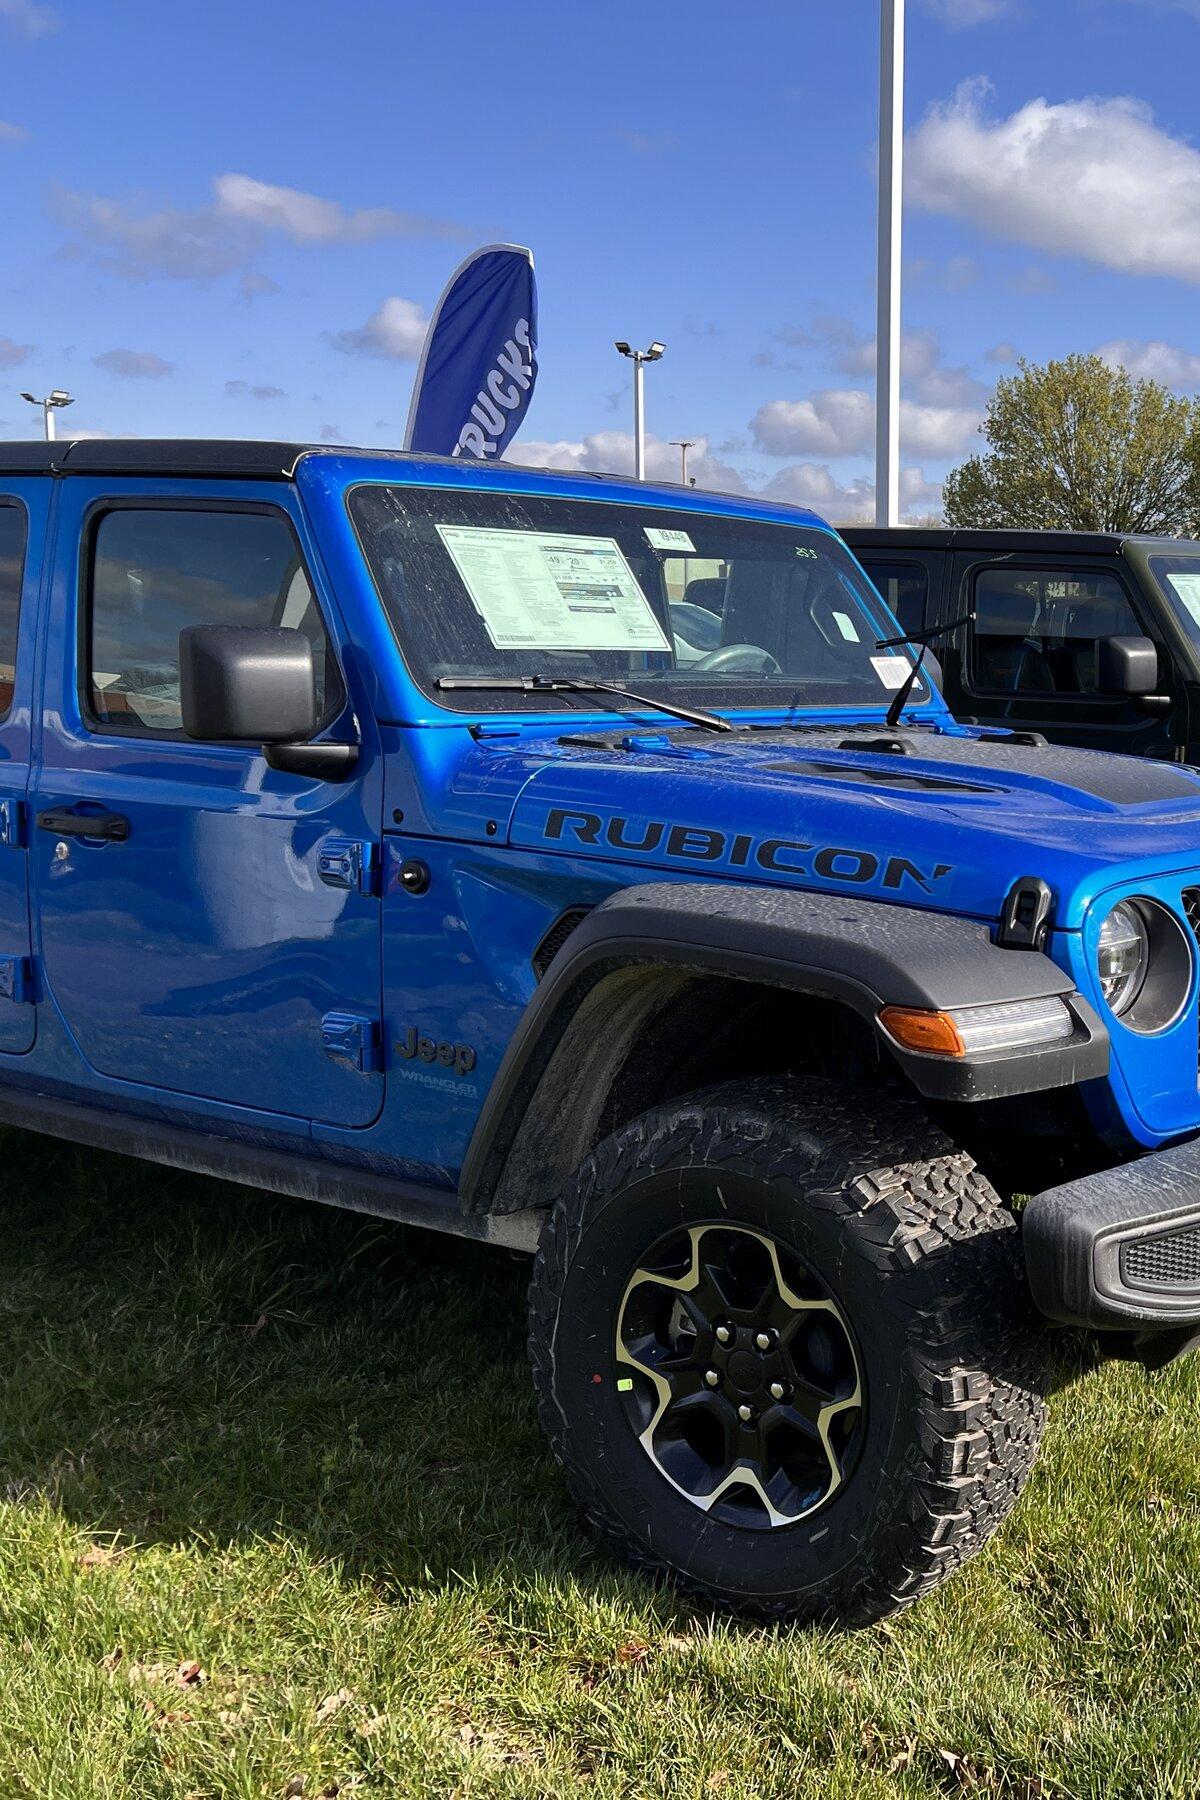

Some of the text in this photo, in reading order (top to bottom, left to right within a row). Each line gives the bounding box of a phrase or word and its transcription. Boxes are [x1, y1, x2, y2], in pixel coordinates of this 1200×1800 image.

[543, 808, 957, 895] RUBICON
[395, 1026, 477, 1077] Jeep
[399, 1068, 478, 1094] WRANGLER
